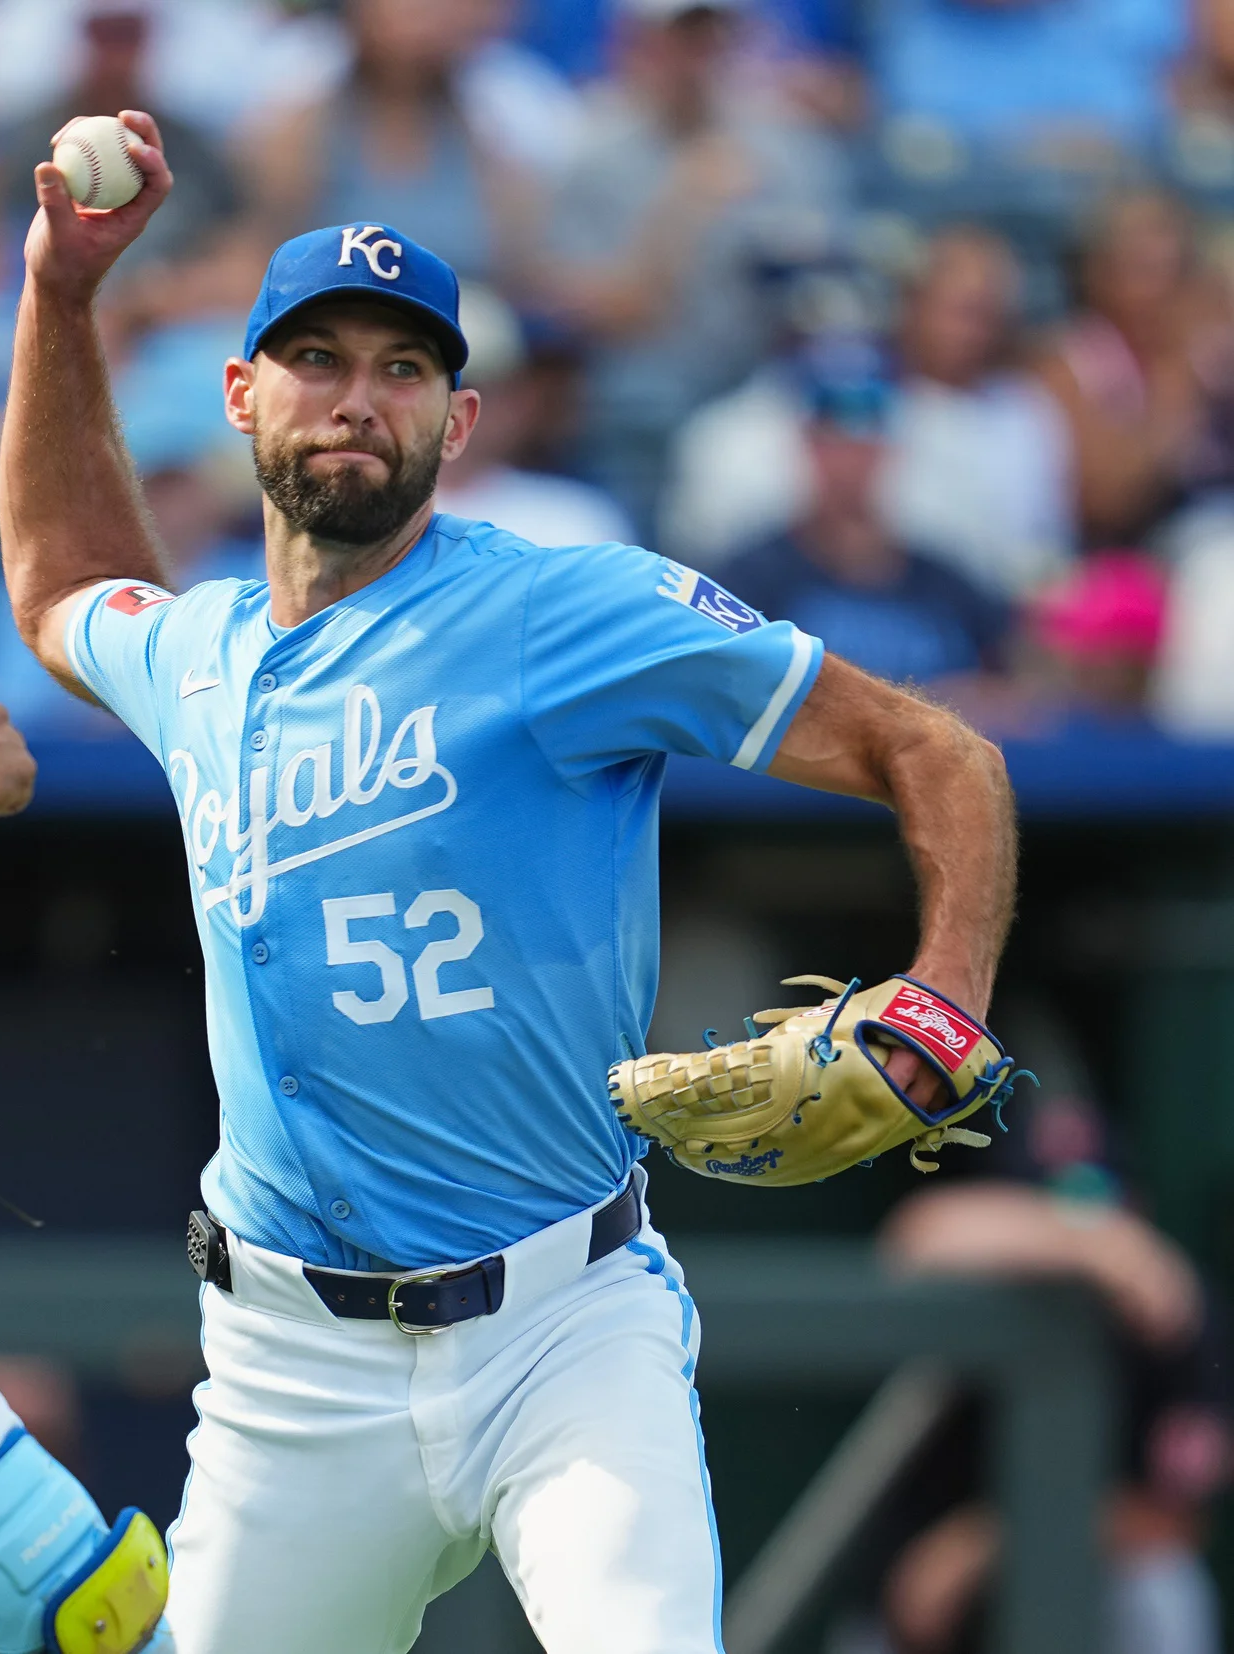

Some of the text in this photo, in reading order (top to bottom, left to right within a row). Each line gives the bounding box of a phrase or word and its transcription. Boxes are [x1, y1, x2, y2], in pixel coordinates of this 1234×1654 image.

[338, 226, 402, 280] KC
[697, 590, 755, 631] KC
[169, 684, 458, 927] Royals
[322, 889, 495, 1026] 52
[894, 1005, 968, 1049] Rawlings
